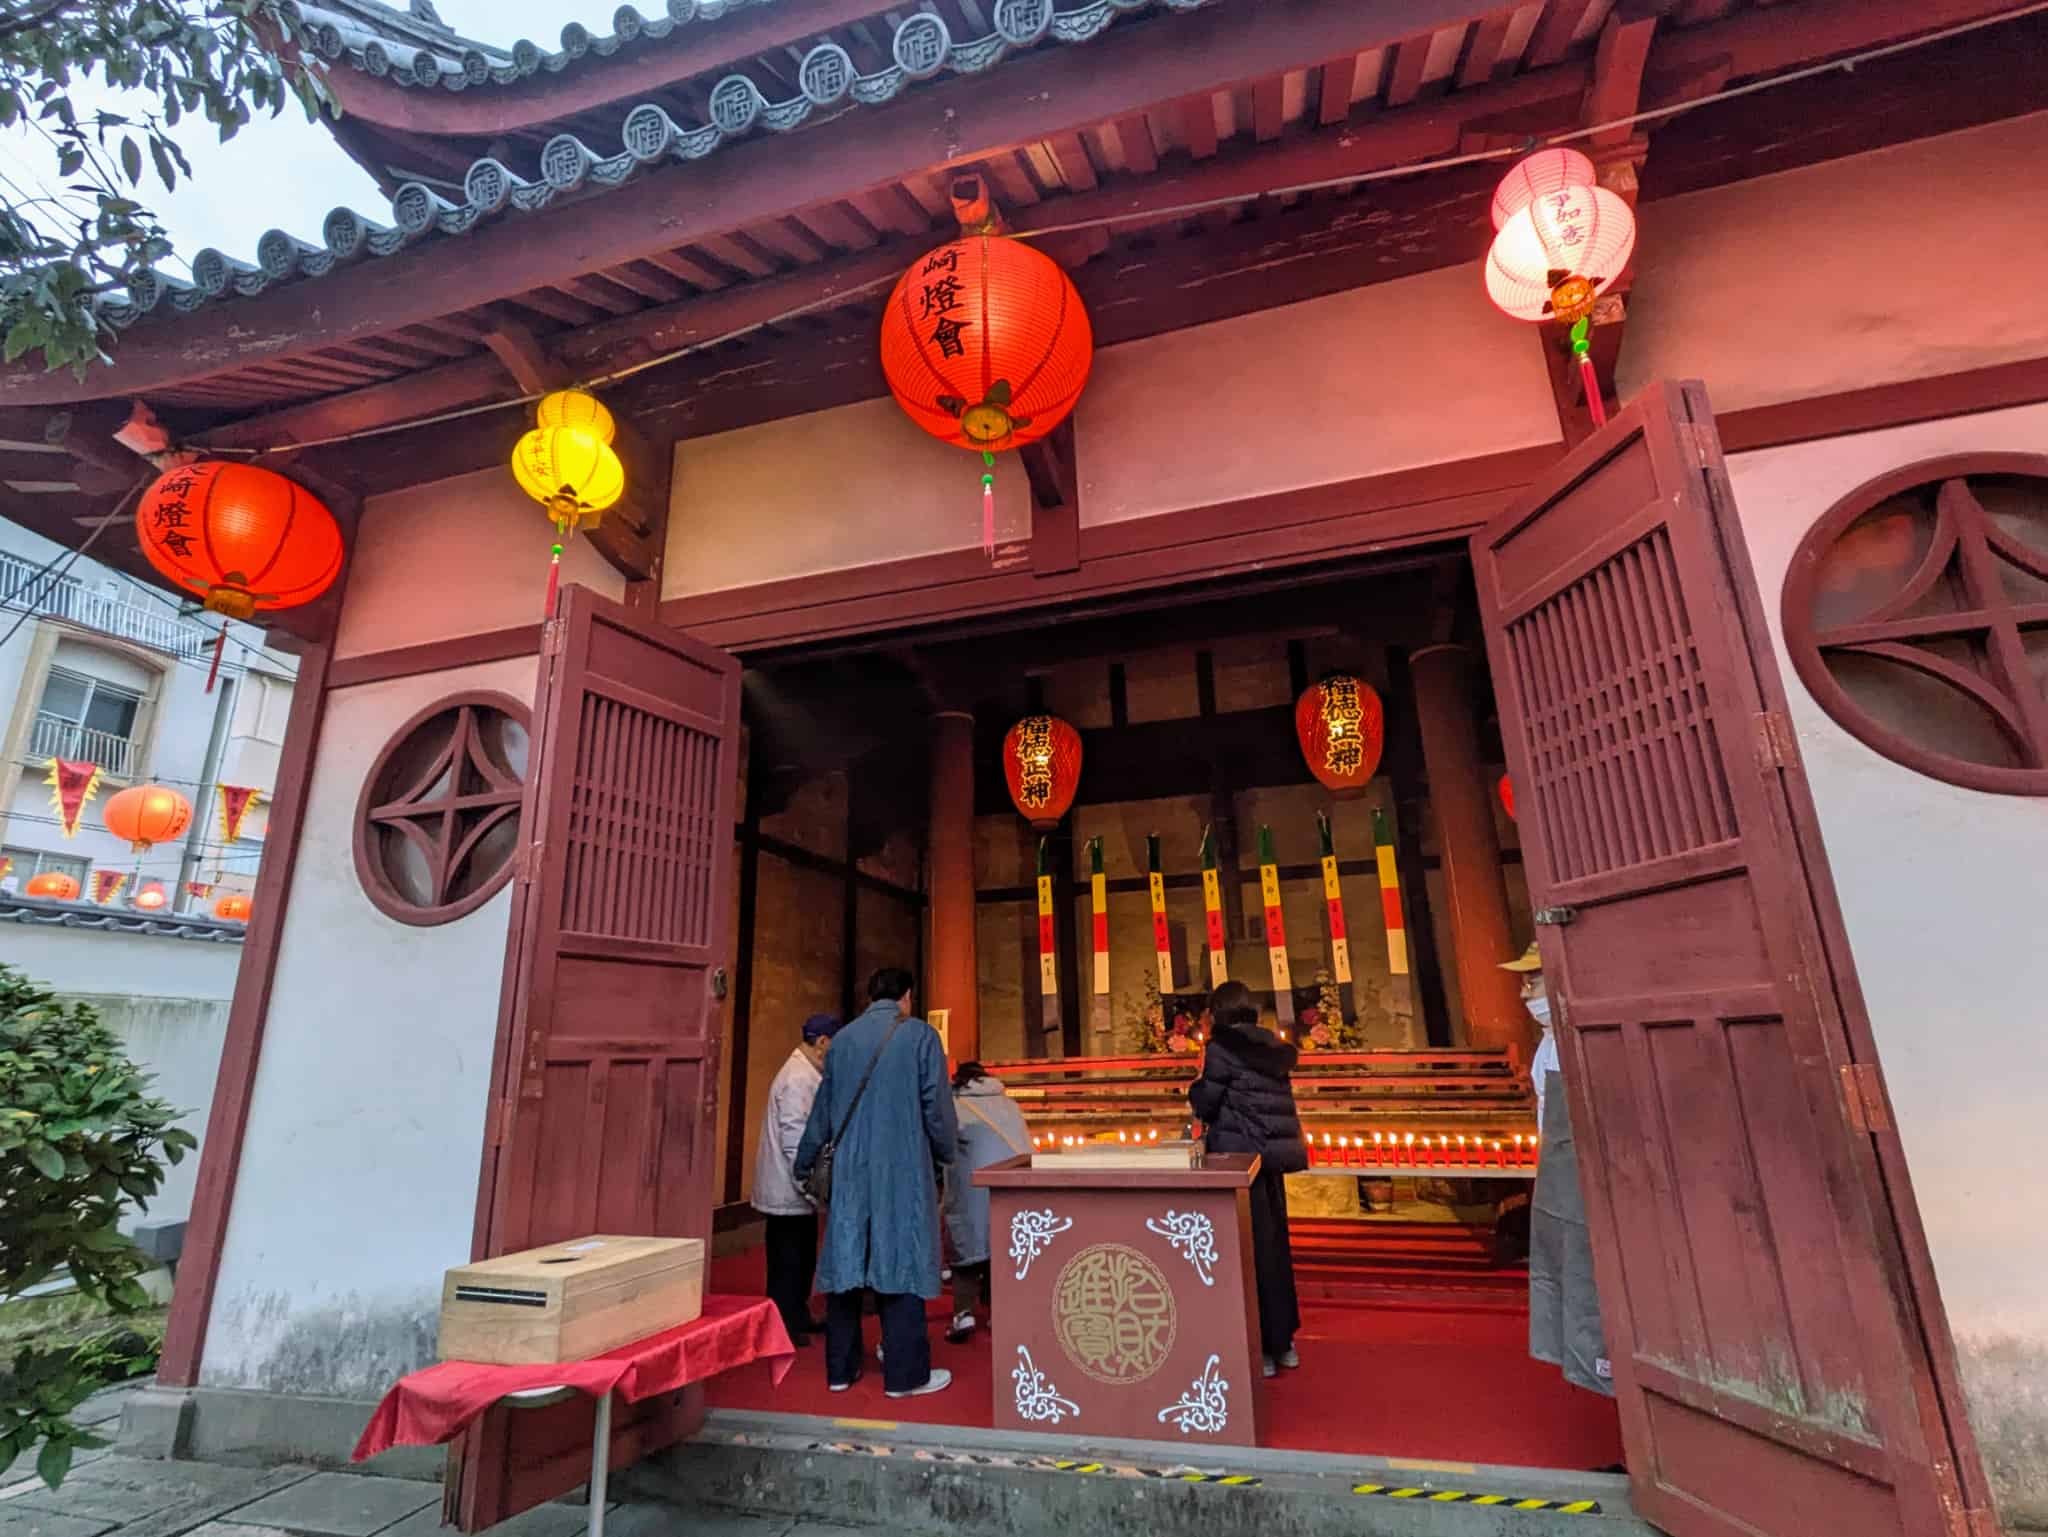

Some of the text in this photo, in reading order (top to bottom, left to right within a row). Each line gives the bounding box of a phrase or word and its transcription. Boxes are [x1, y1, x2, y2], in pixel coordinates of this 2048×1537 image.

[902, 21, 938, 71] 福
[806, 53, 842, 102] 福
[715, 83, 750, 128] 福
[627, 111, 662, 157] 福
[470, 162, 500, 206] 福
[550, 143, 579, 187] 福
[919, 243, 974, 360] 崎燈會
[153, 469, 207, 557] 崎燈會
